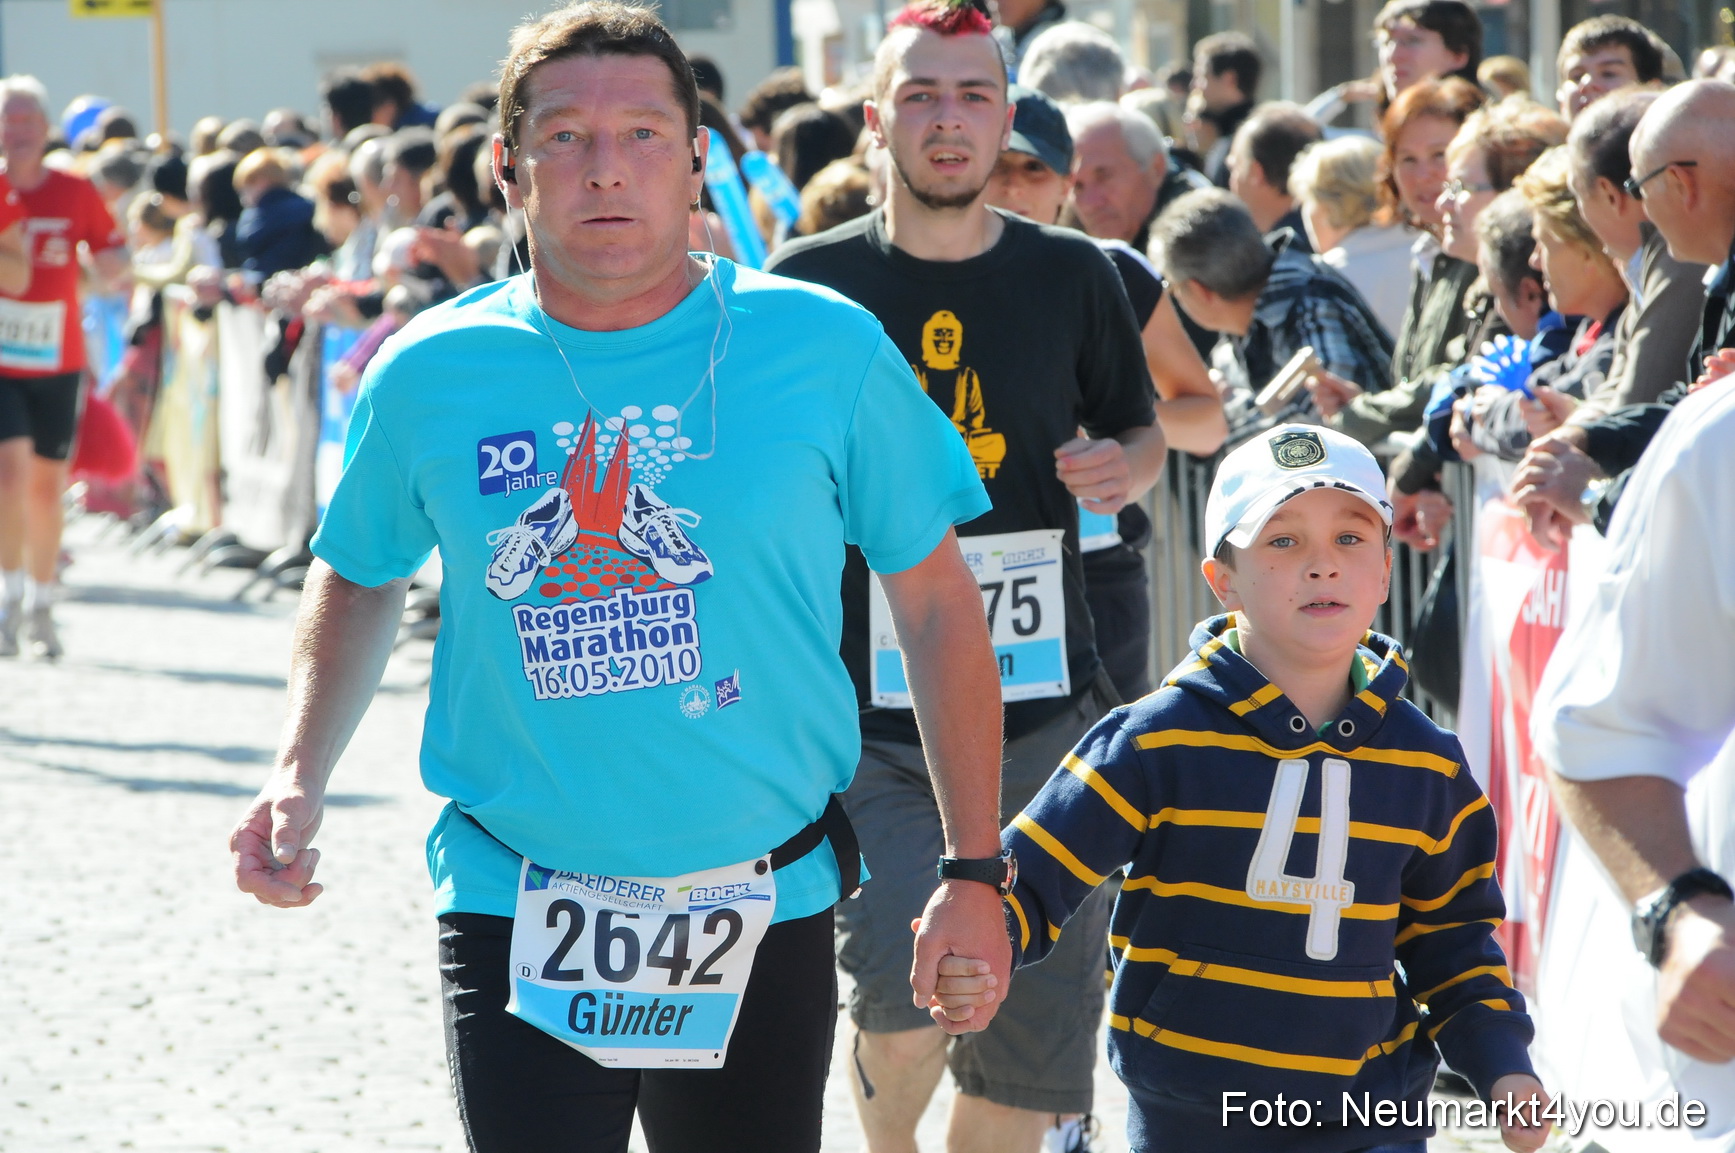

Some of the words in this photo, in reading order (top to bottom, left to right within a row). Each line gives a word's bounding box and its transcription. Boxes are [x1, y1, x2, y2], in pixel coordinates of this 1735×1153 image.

[480, 440, 535, 480] 20
[504, 470, 558, 497] jahre
[517, 593, 690, 634] Regensburg
[524, 620, 694, 663] Marathon
[530, 649, 697, 695] 16.05.2010
[1246, 758, 1355, 961] 4
[551, 881, 663, 911] AKTIENGESELLSCHAFT
[689, 883, 751, 902] BOCK
[1256, 879, 1349, 901] HAYSVILLE
[541, 898, 743, 986] 2642
[522, 965, 531, 978] D
[568, 992, 693, 1036] Günter
